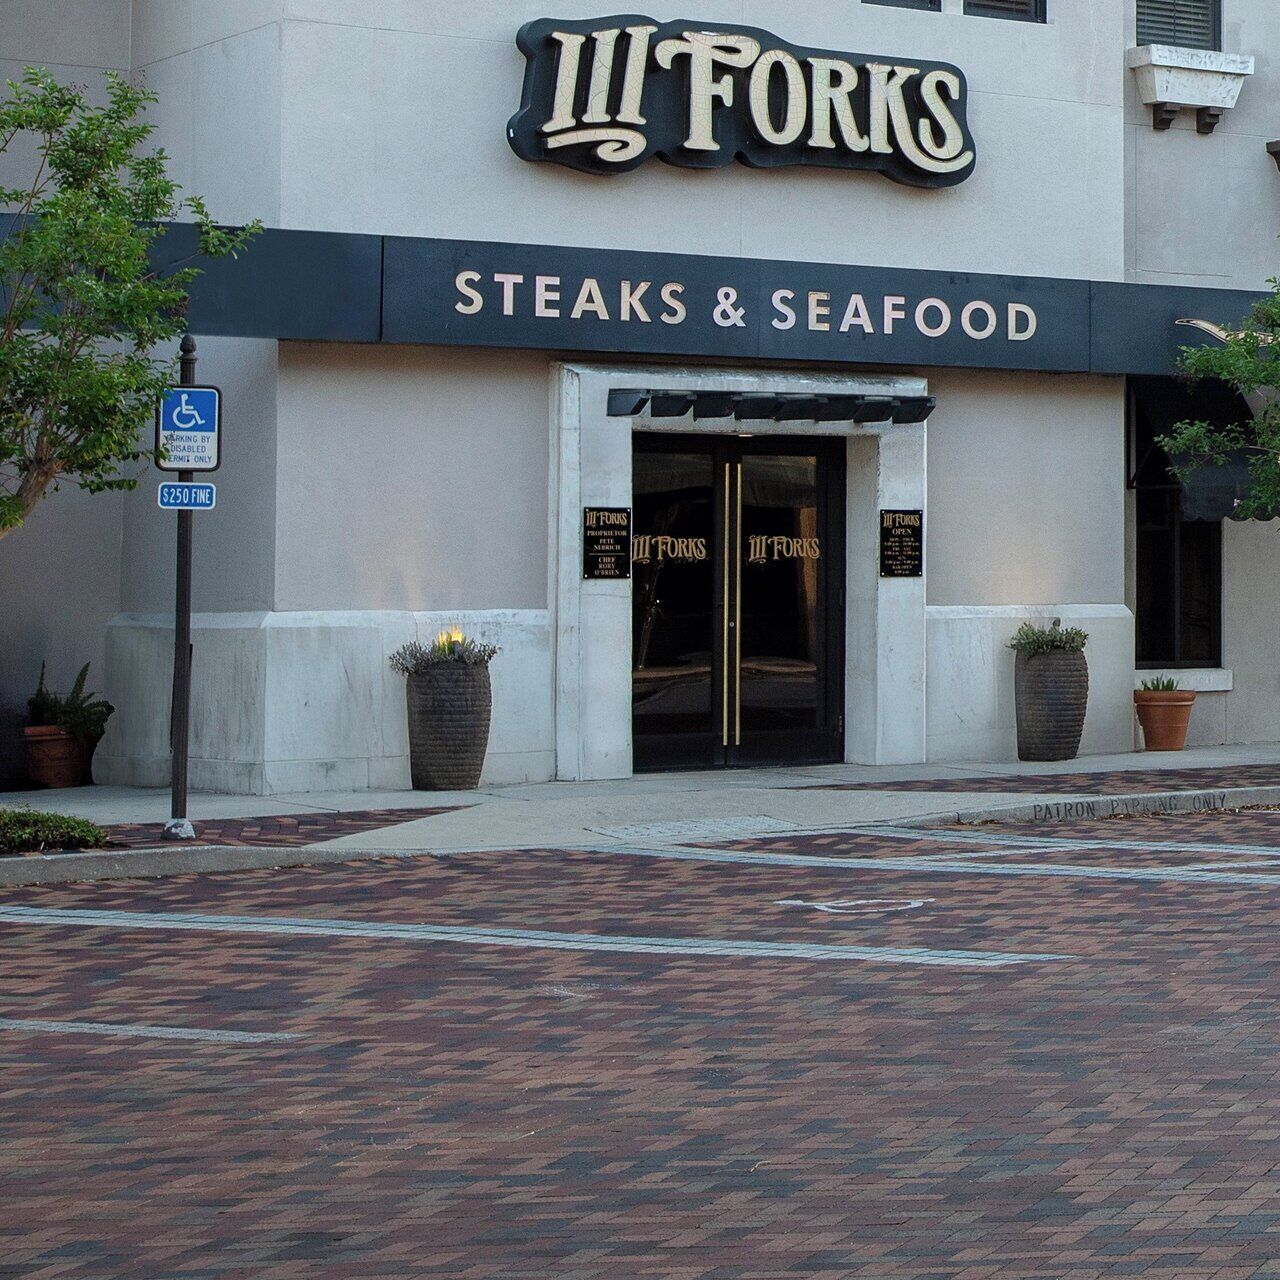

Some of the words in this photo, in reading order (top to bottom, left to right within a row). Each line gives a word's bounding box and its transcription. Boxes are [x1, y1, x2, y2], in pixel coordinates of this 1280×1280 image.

[655, 31, 974, 174] FORKS
[455, 270, 688, 326] STEAKS
[712, 286, 747, 329] &
[770, 288, 1038, 343] SEAFOOD
[201, 434, 211, 443] BY
[171, 445, 207, 453] DISABLED
[167, 455, 191, 463] ERMIT
[193, 455, 213, 463] ONLY
[162, 488, 189, 504] $250
[191, 488, 211, 504] FINE
[597, 511, 628, 526] FORKS
[893, 513, 920, 527] FORKS
[651, 535, 707, 560] FORKS
[768, 535, 821, 560] FORKS
